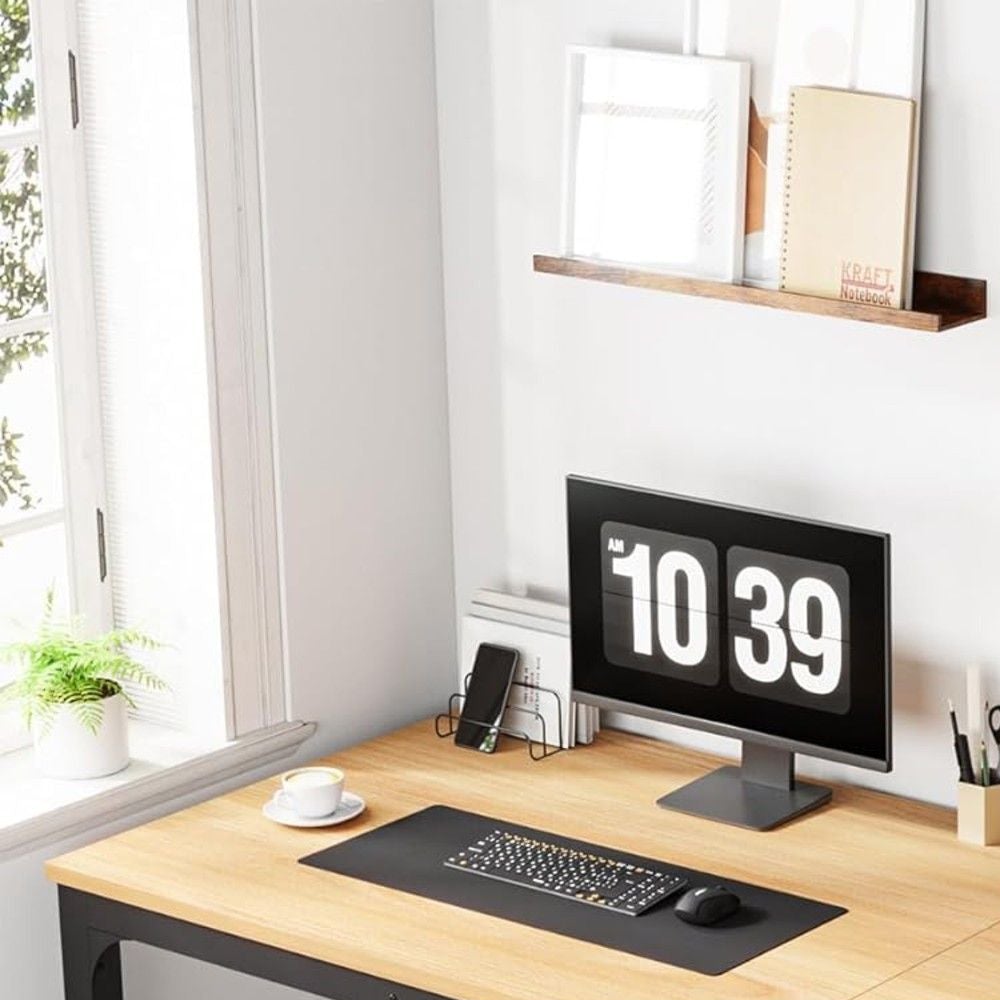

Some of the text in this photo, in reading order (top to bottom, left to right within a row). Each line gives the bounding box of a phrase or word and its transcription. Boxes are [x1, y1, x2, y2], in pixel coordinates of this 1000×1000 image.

[841, 260, 892, 288] KRAFT
[840, 284, 892, 306] Notebook
[607, 537, 625, 554] AM
[611, 542, 843, 695] 10 39
